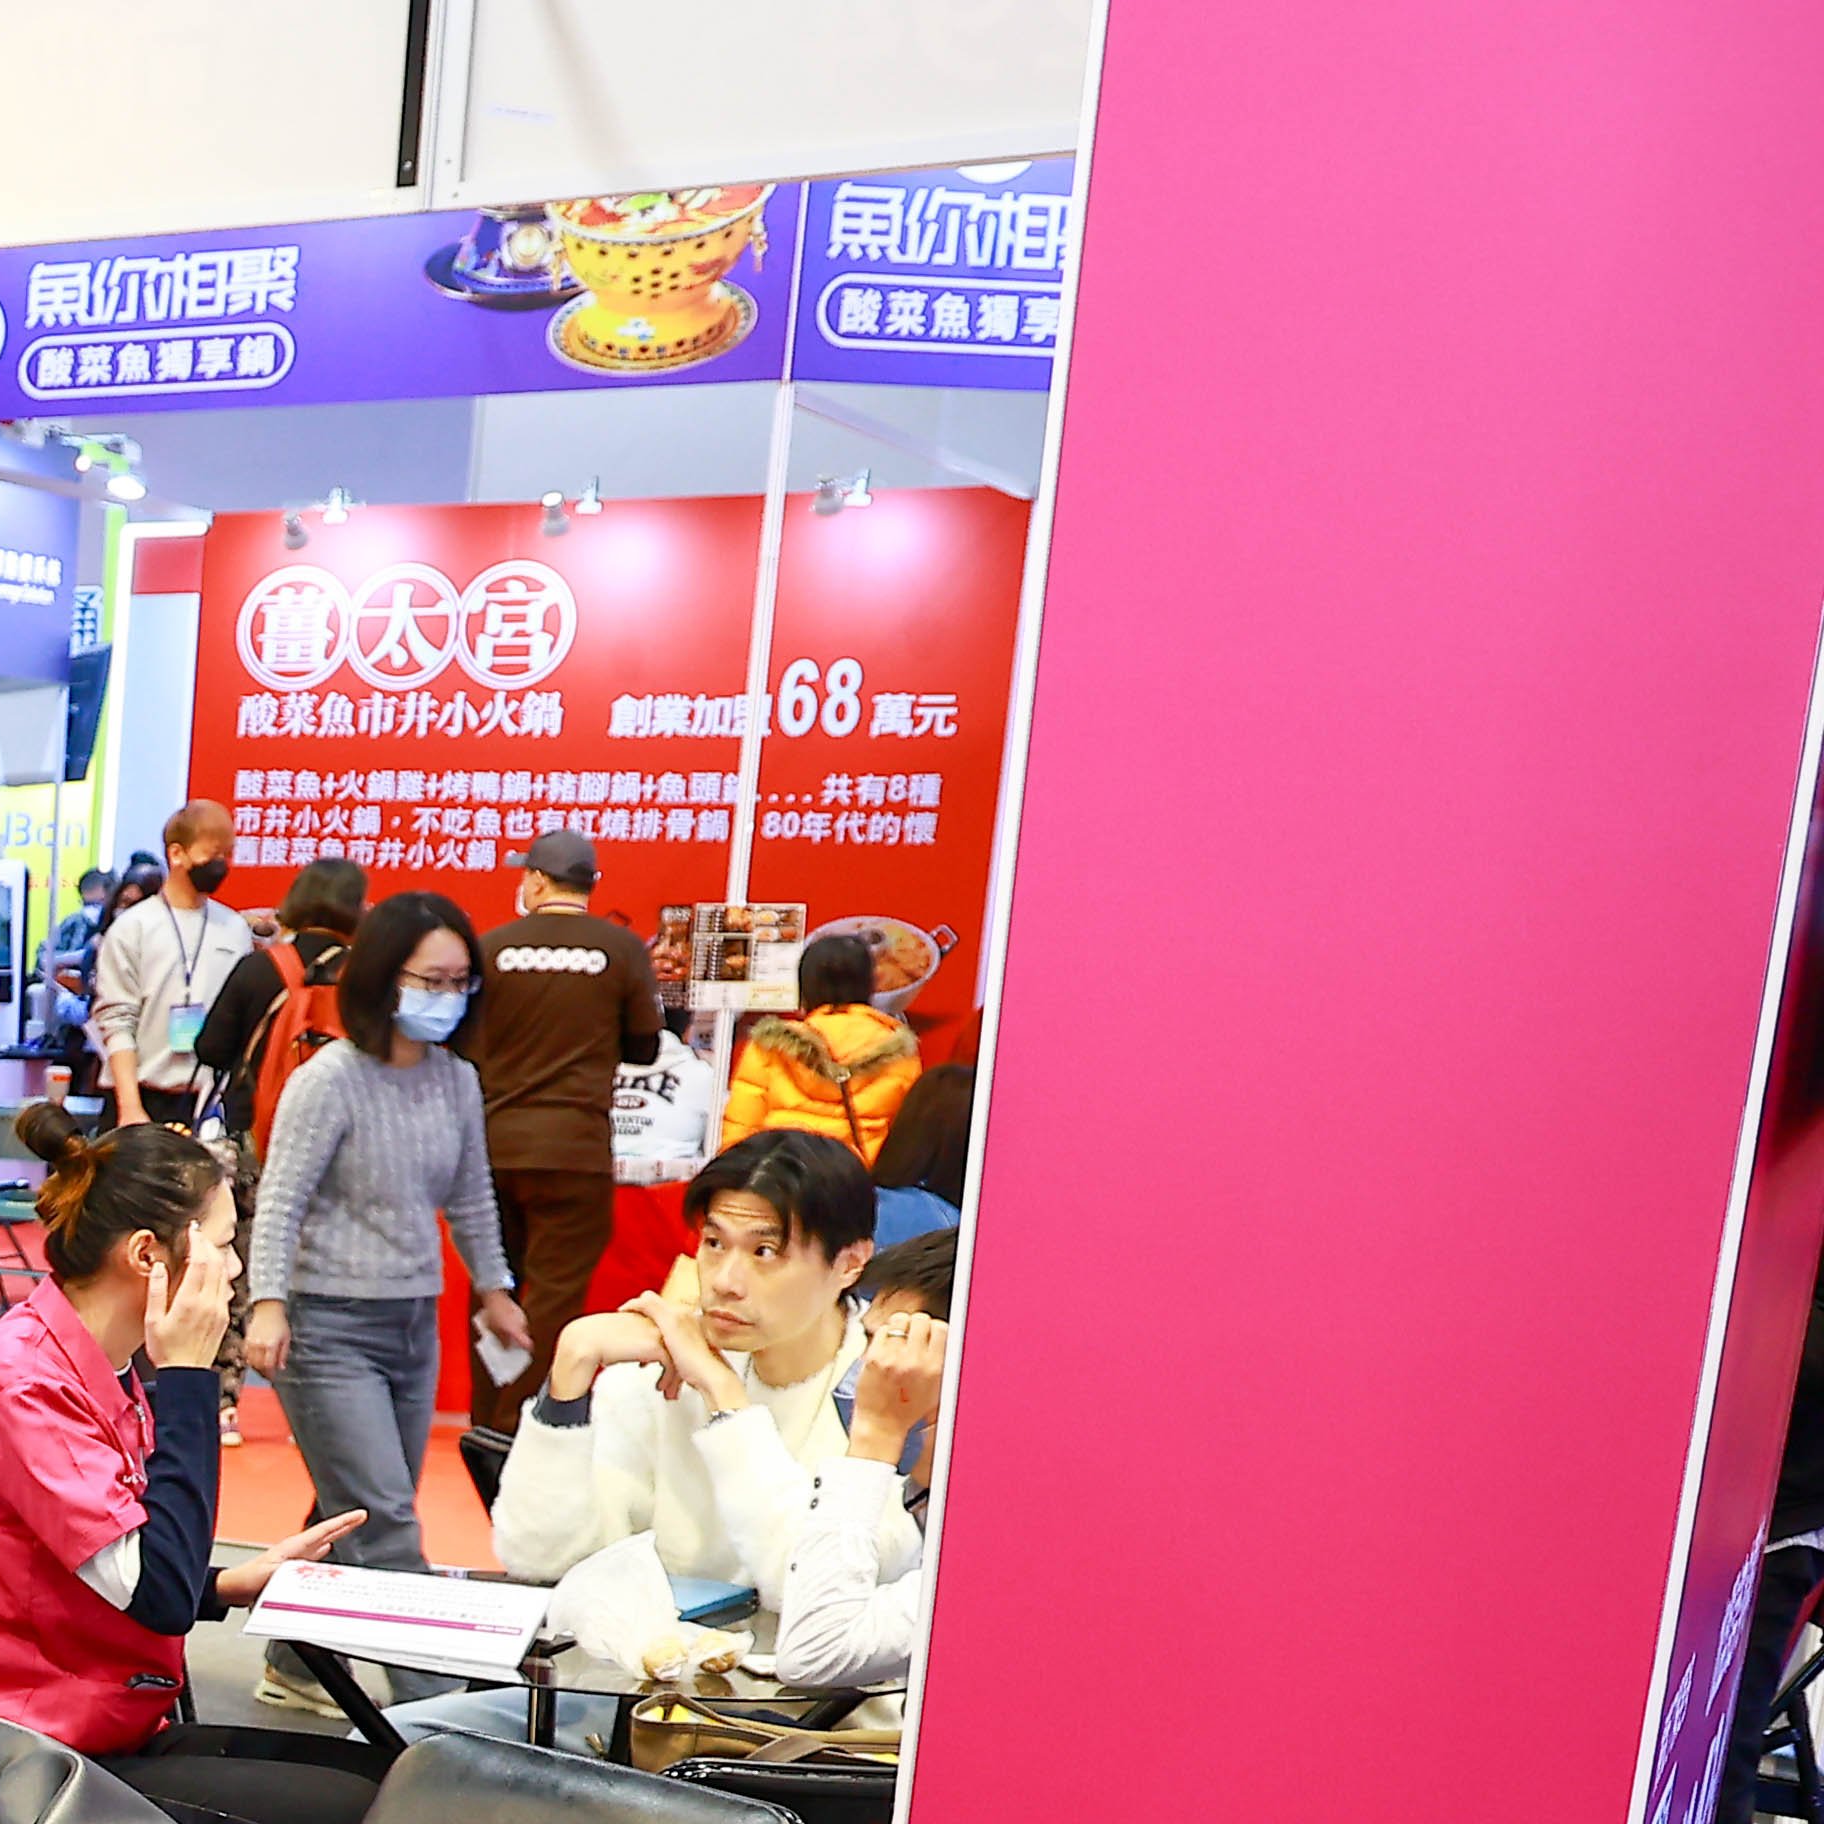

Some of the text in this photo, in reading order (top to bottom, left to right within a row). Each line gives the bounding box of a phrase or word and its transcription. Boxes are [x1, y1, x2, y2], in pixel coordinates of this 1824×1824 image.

[826, 182, 1070, 270] 魚你相
[25, 245, 300, 329] 魚你相聚
[36, 335, 277, 388] 酸菜魚獨享鍋
[236, 690, 565, 740] 酸菜魚市井小火鍋
